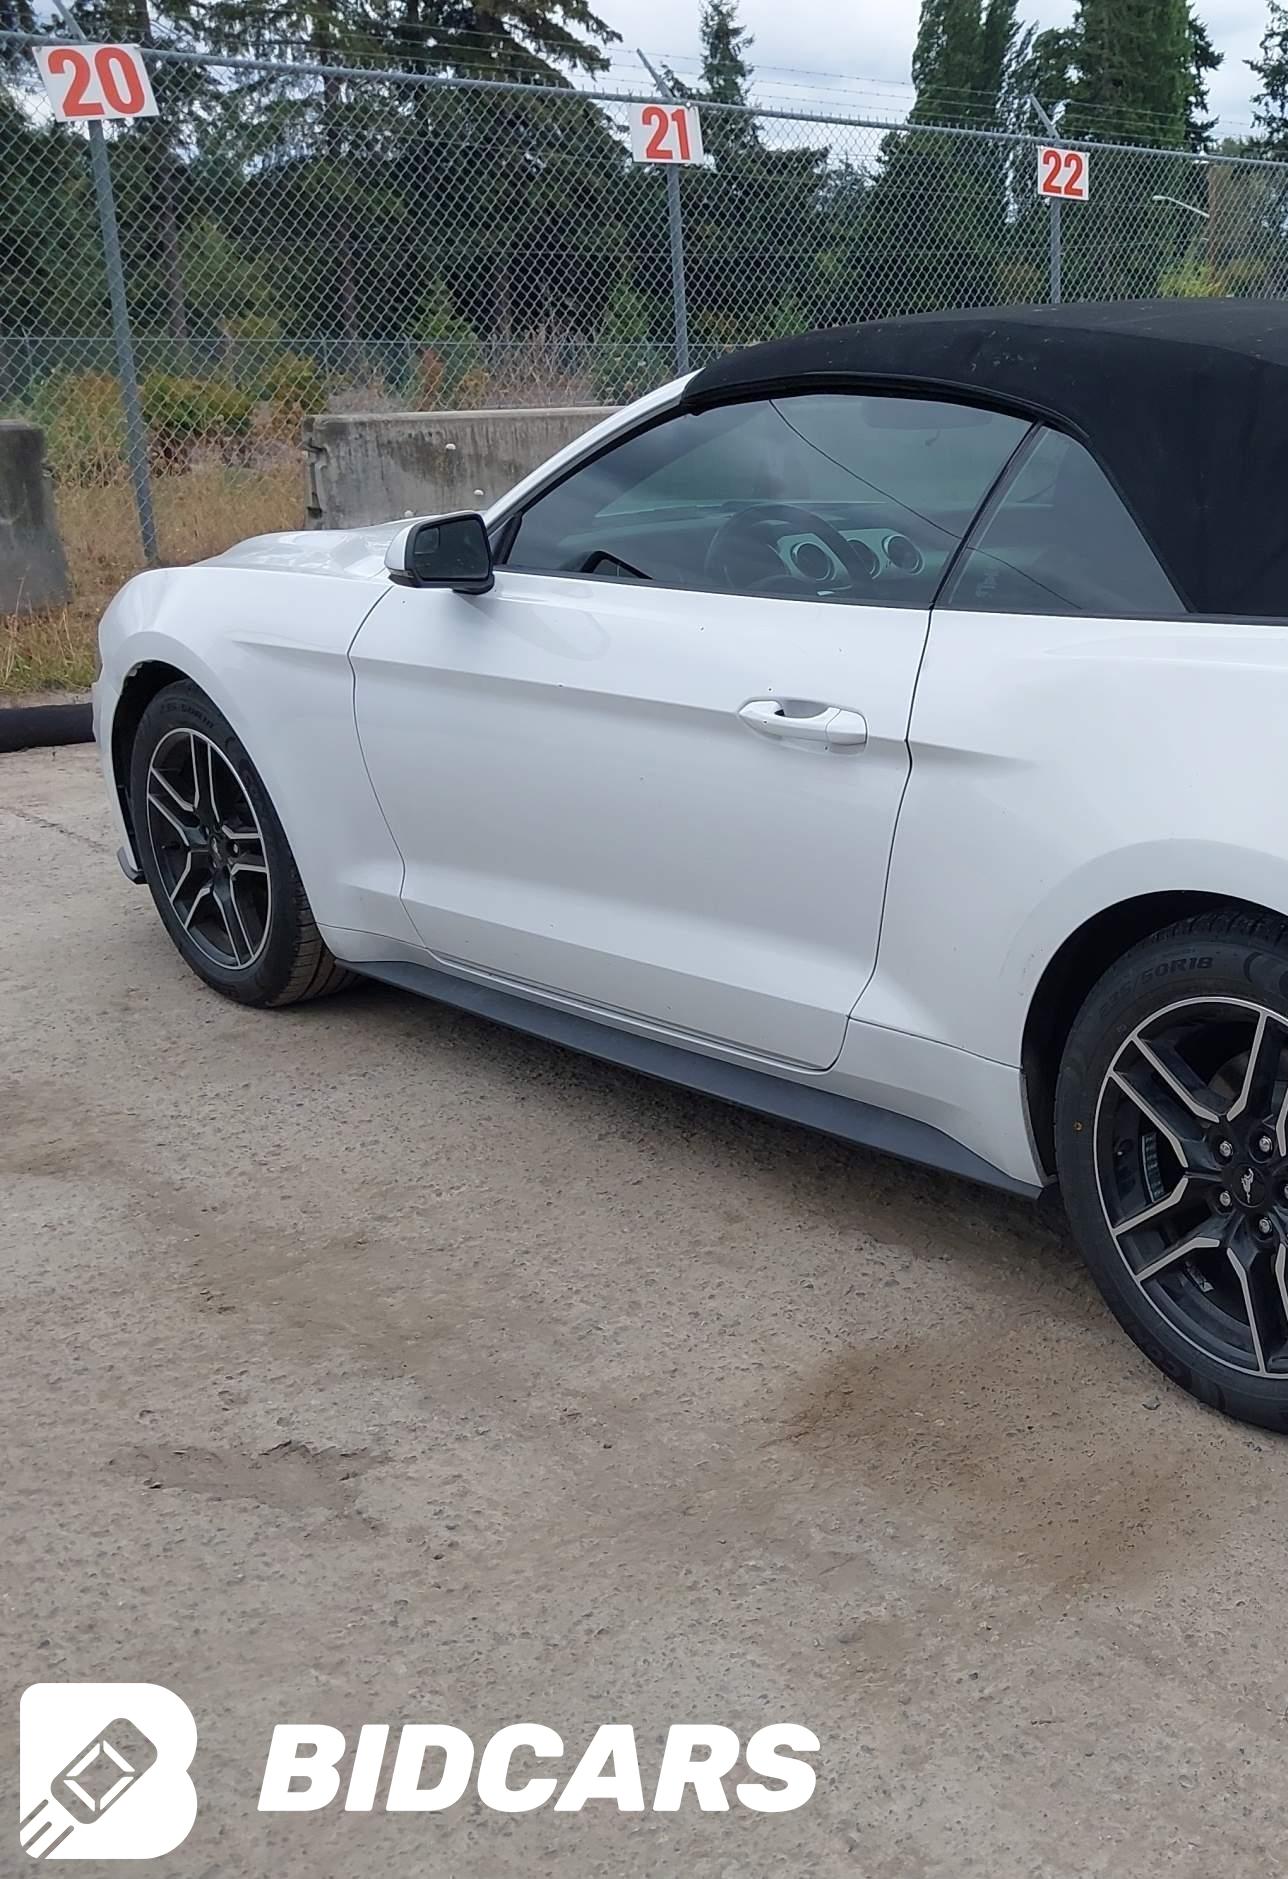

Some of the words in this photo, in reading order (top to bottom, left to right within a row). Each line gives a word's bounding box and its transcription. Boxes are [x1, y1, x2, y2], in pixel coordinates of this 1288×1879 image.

[47, 46, 146, 119] 20
[641, 105, 692, 161] 21
[1041, 149, 1085, 197] 22
